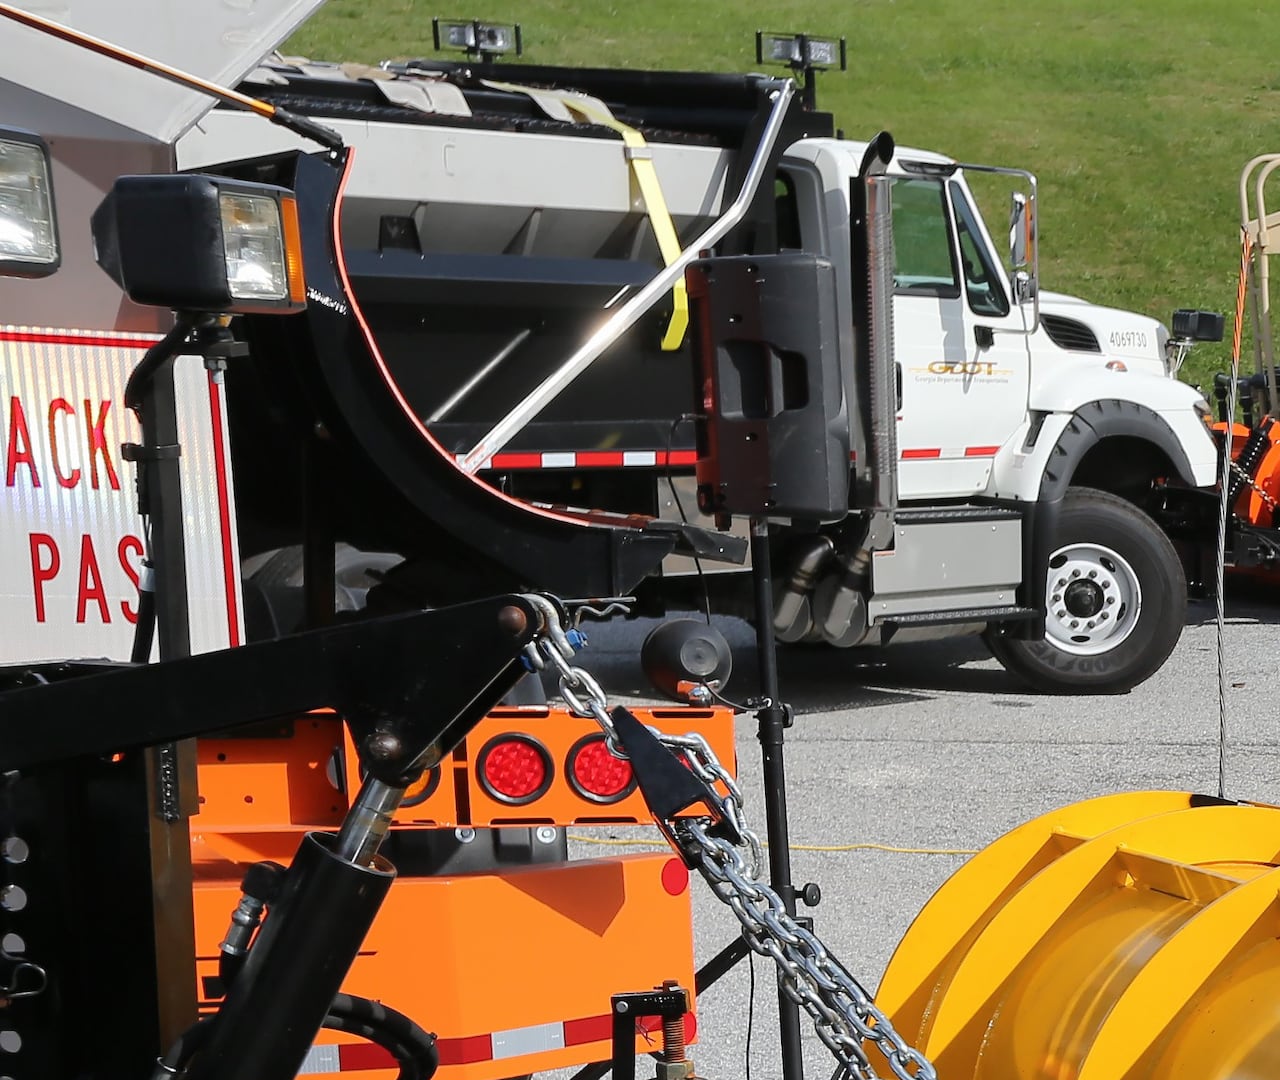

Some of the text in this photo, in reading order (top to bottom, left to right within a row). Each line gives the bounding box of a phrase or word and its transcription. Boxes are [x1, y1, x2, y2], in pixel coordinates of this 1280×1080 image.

[1109, 331, 1147, 348] 4069730
[927, 360, 998, 376] GDOT
[6, 396, 121, 490] ACK
